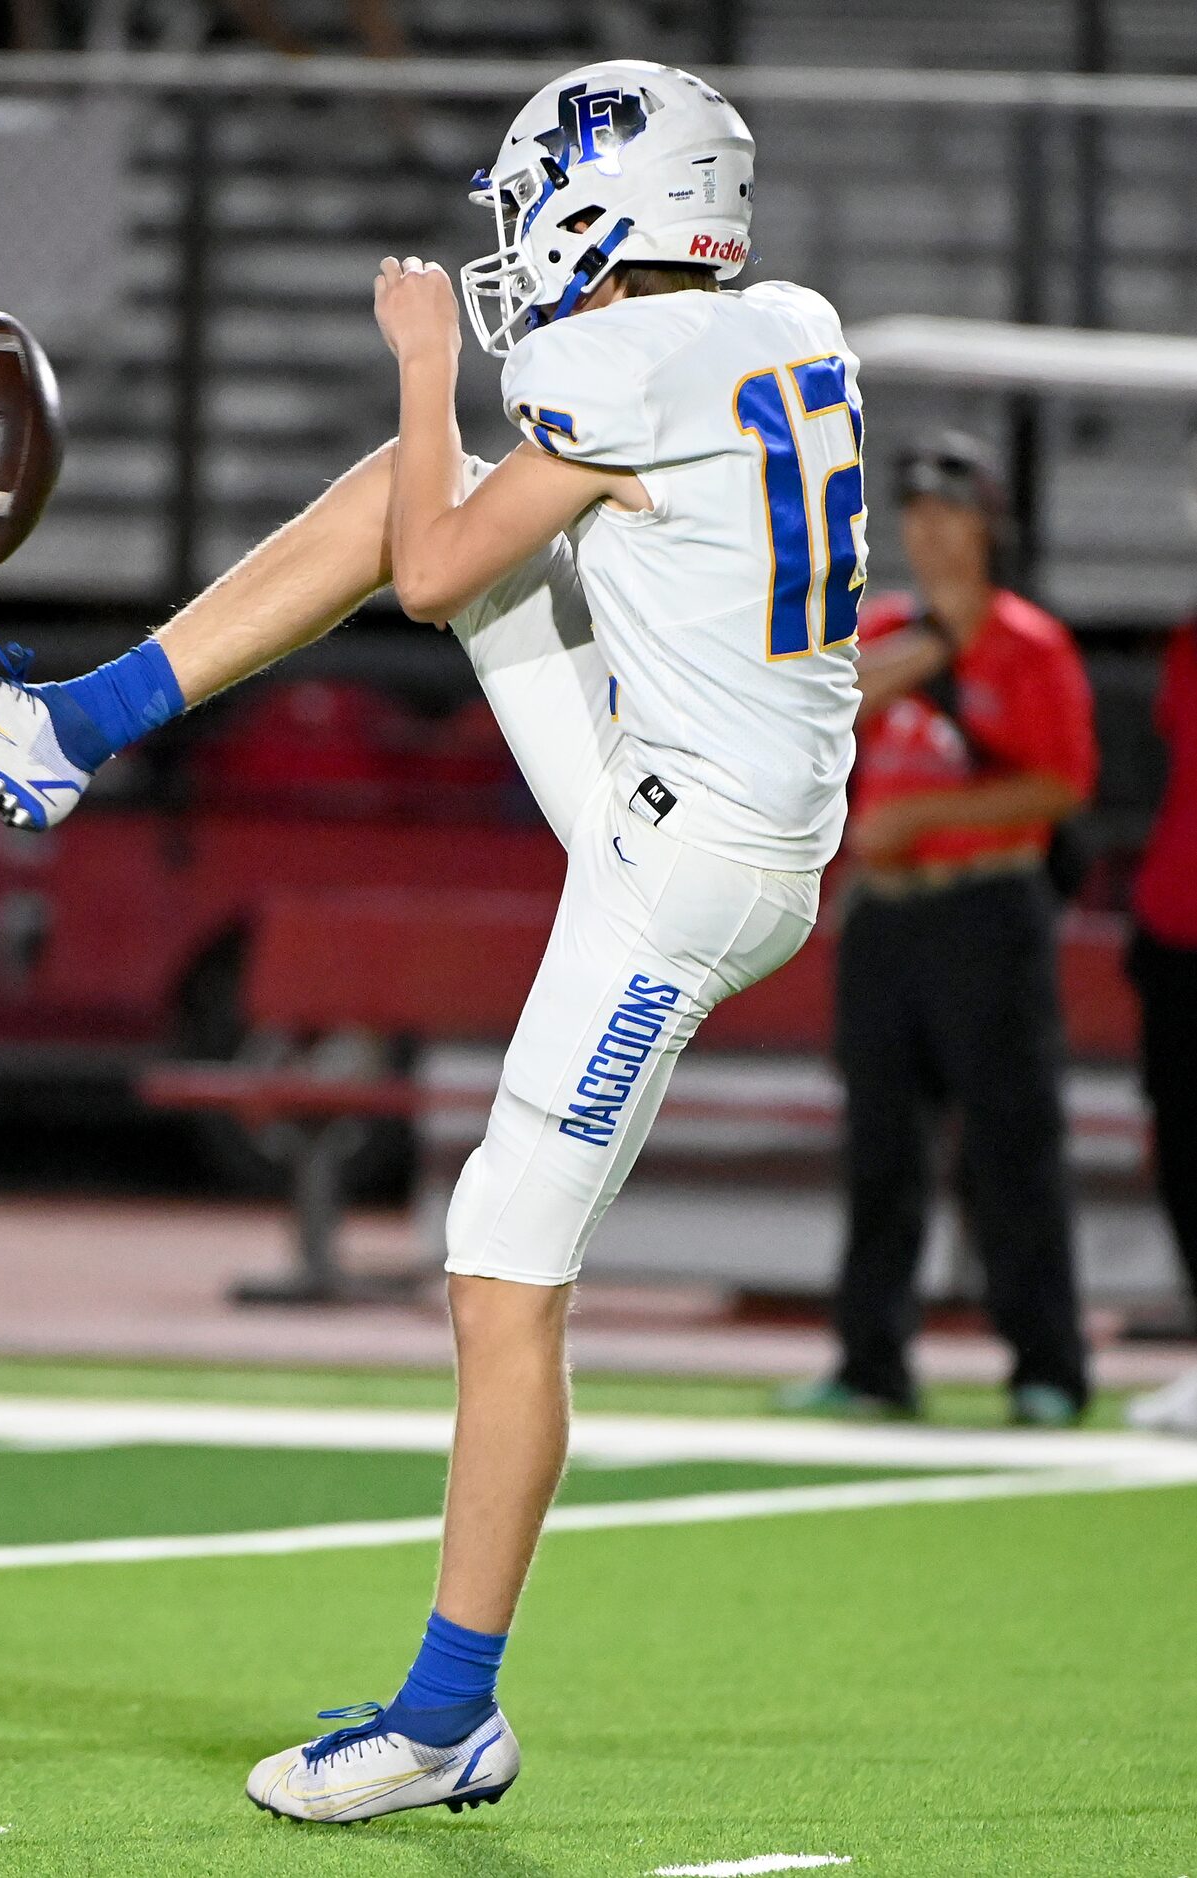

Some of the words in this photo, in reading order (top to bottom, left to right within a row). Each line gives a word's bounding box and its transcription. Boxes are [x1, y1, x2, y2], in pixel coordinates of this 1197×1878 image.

[568, 86, 624, 170] F
[732, 352, 865, 662] 12
[647, 785, 665, 804] M
[559, 974, 681, 1147] RACCOONS
